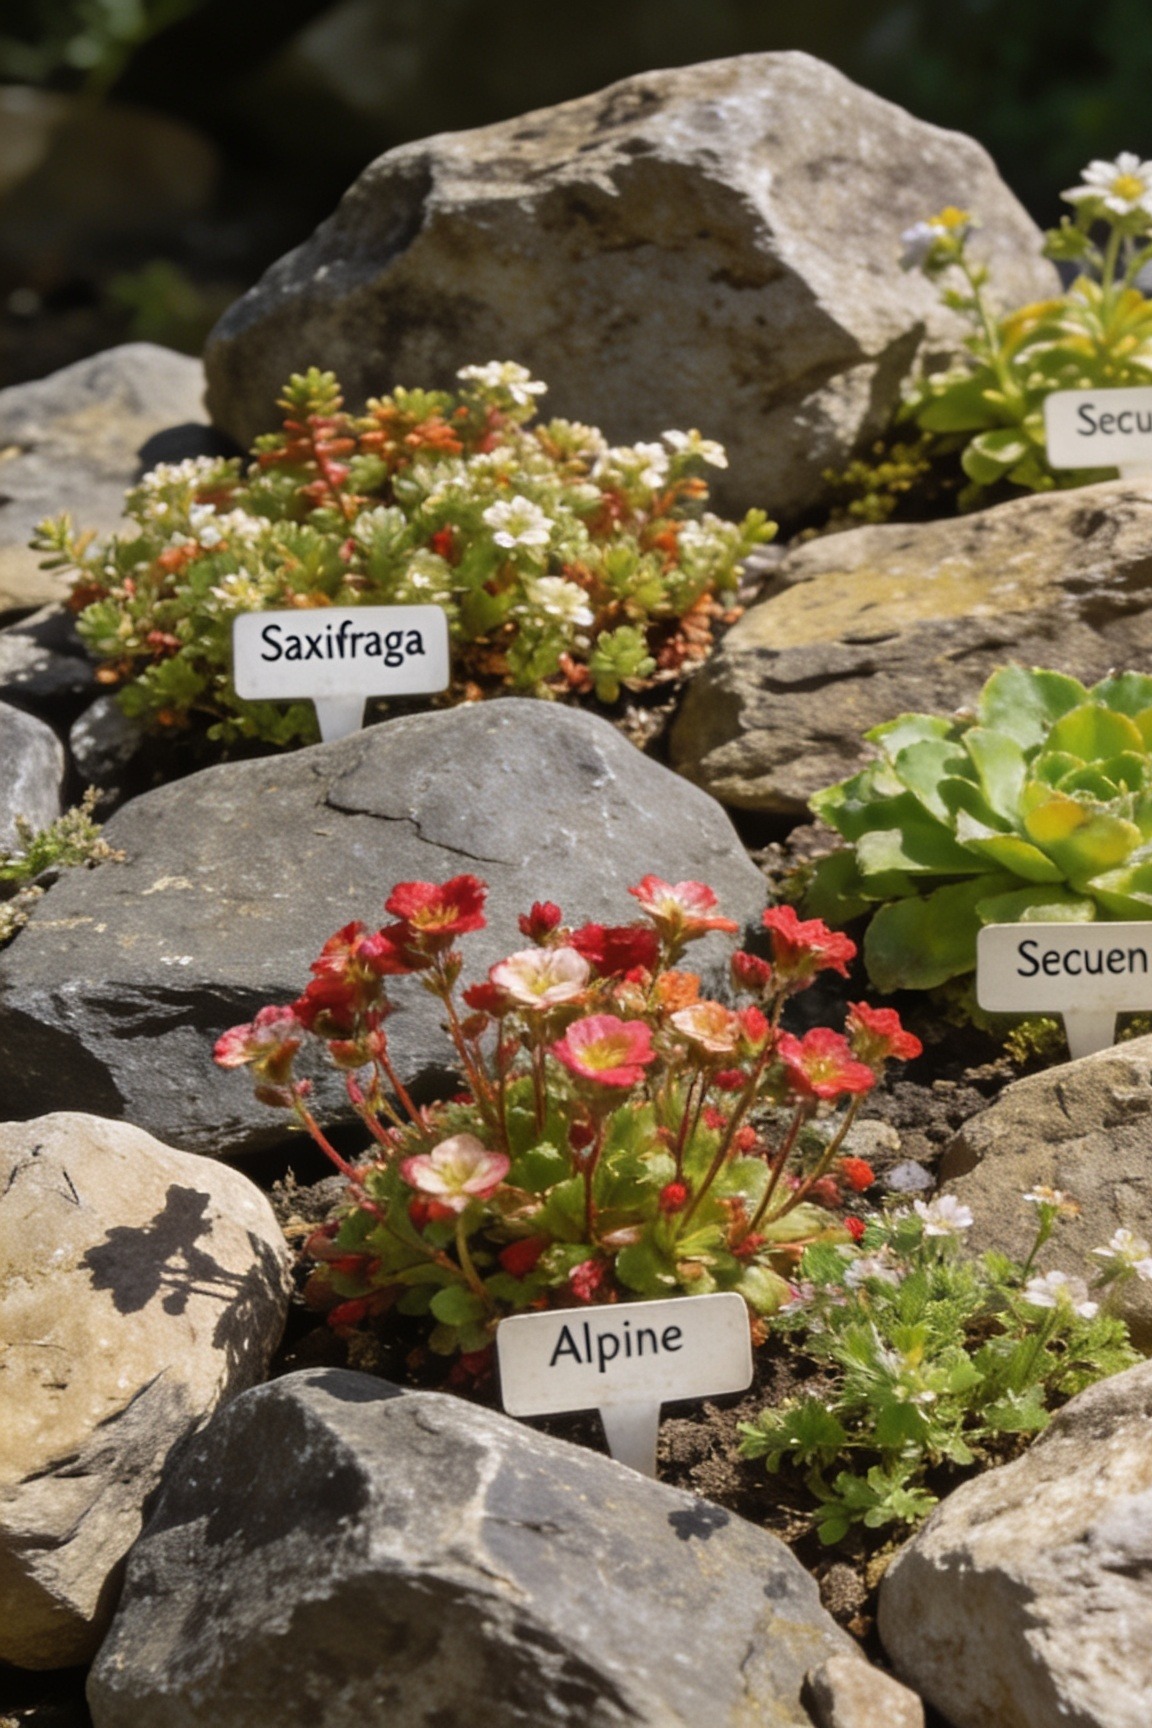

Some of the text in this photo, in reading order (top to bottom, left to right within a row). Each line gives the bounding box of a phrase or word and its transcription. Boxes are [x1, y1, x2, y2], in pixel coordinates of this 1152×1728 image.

[260, 619, 426, 668] Saxifraga
[1016, 939, 1148, 978] Secuen
[548, 1320, 684, 1374] Alpine
